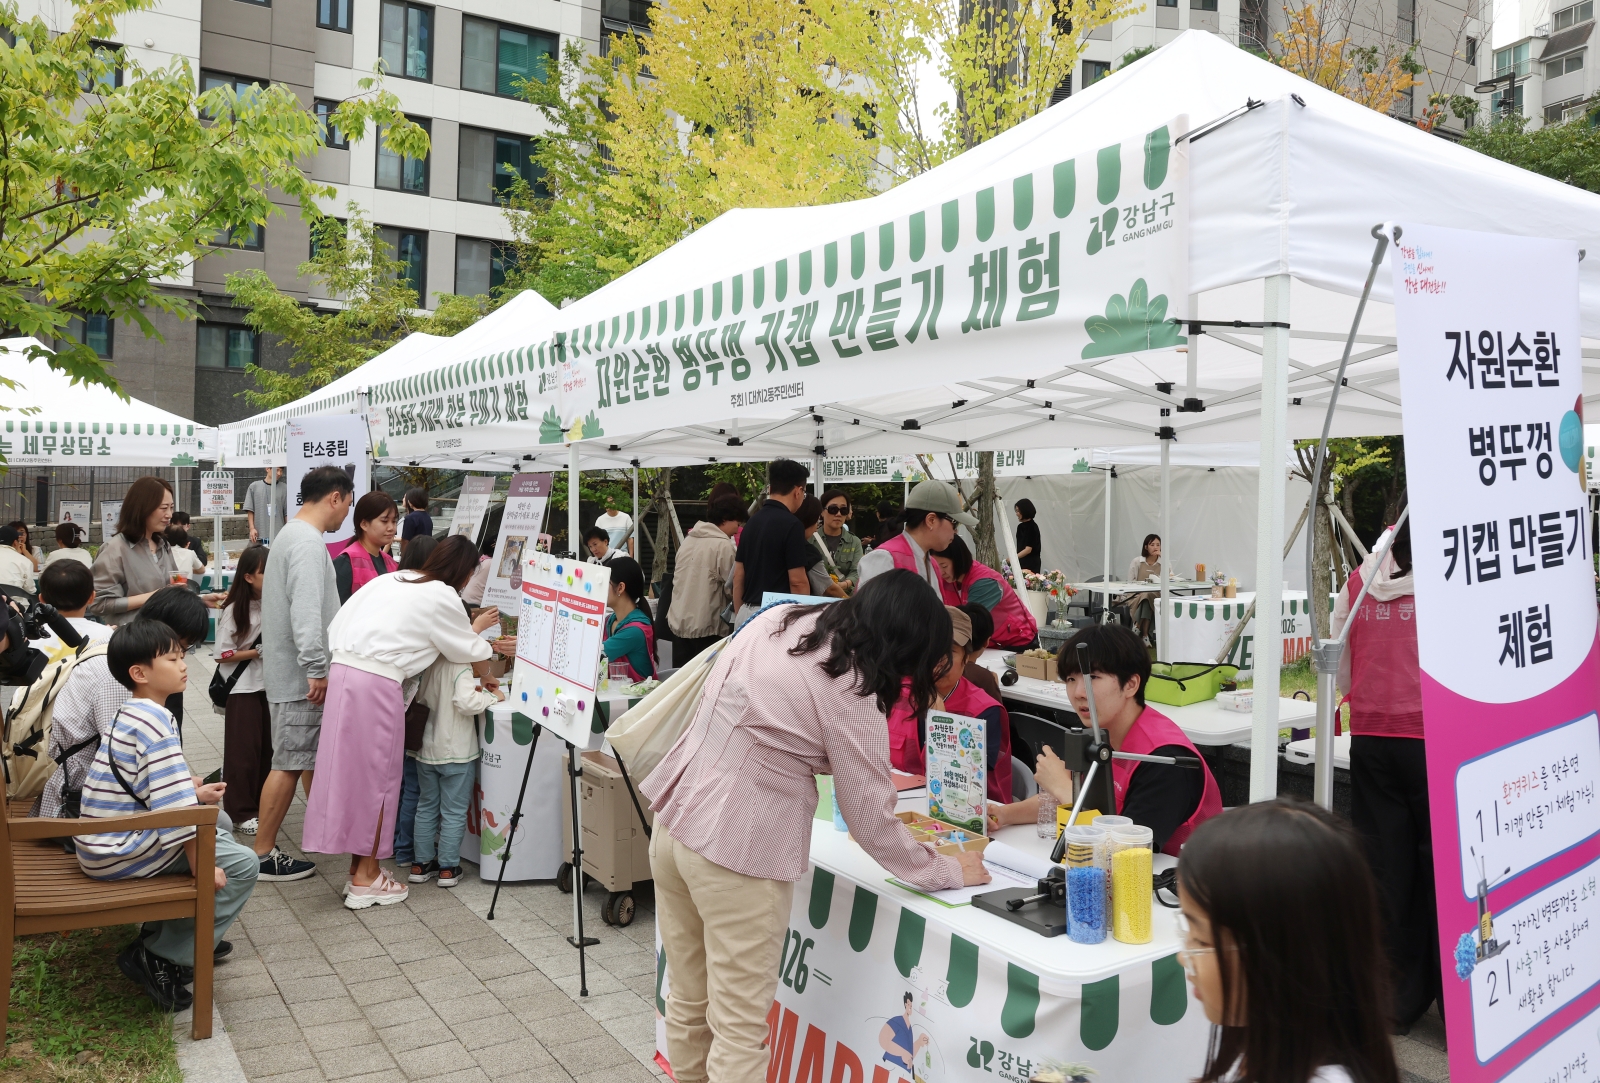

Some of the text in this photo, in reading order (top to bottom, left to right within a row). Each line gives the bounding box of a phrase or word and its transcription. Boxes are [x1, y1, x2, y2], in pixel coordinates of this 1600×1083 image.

[1122, 191, 1175, 229] 강남구
[1122, 219, 1174, 242] GANG NAM GU
[1405, 276, 1418, 294] 강남
[594, 230, 1061, 409] 자원순환 병뚜껑 키캡 만들기 체험
[1444, 330, 1561, 389] 자원순환
[386, 403, 417, 437] 탄소중립
[469, 385, 501, 427] 꾸미기
[504, 380, 529, 422] 체험
[730, 381, 804, 408] 주최 대치2동주민센터
[22, 435, 111, 456] 세무상담소
[303, 440, 348, 458] 탄소중립
[996, 449, 1025, 468] 플라워
[1468, 421, 1553, 486] 병뚜껑
[1442, 506, 1587, 586] 키캡 만들기
[1280, 618, 1296, 634] 026
[1498, 603, 1553, 669] 체험
[930, 731, 946, 743] 병뚜껑
[1502, 766, 1549, 805] 환경퀴즈를
[1504, 812, 1524, 838] 키캡
[1526, 801, 1553, 830] 만들기
[1556, 790, 1575, 813] 체험
[1576, 780, 1595, 804] 가능!
[1512, 908, 1540, 945] 갈아진
[1541, 889, 1578, 922] 병뚜껑을
[1515, 940, 1551, 977] 사출기를
[1554, 917, 1589, 950] 사용하여
[1518, 964, 1576, 1013] 새활용 합니다
[998, 1049, 1041, 1079] 강남
